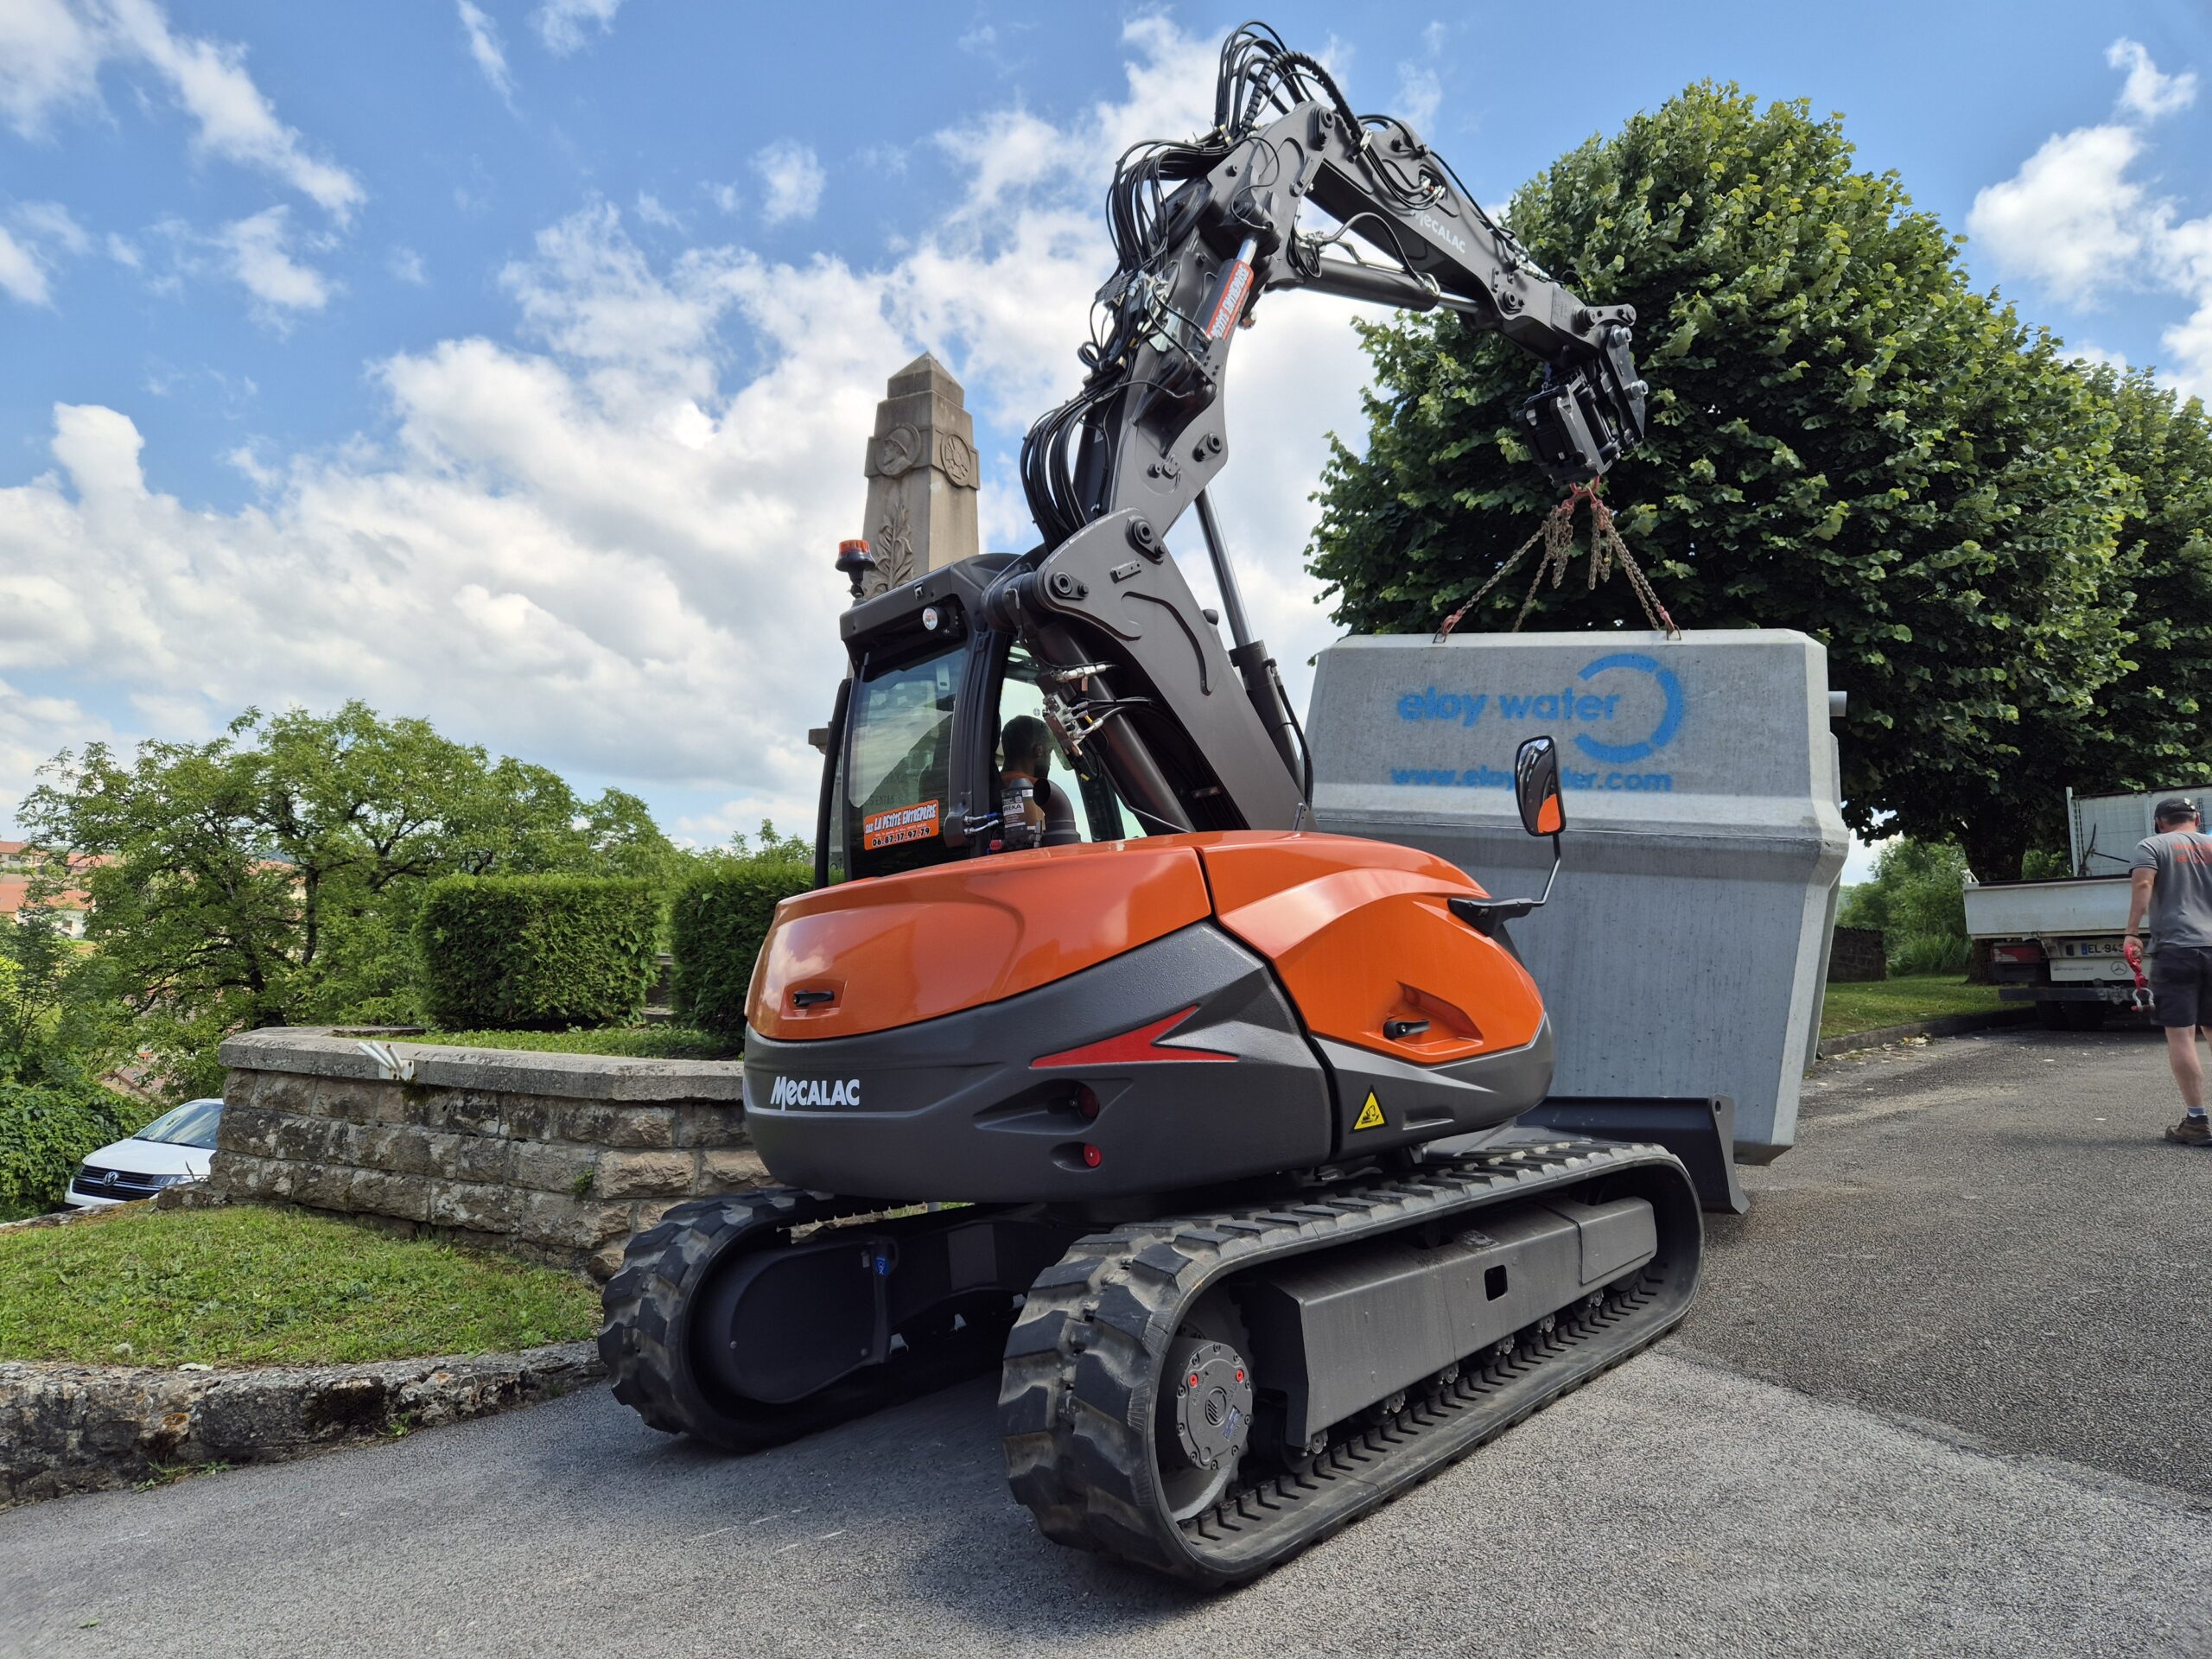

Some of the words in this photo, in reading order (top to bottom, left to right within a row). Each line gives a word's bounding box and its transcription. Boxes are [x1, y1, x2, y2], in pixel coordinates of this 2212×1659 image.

[1396, 686, 1490, 728] eloy
[1497, 687, 1621, 721] water
[1389, 766, 1672, 792] www.eloyter.com
[874, 816, 882, 832] LA
[873, 828, 930, 847] 06.87.17.97.79
